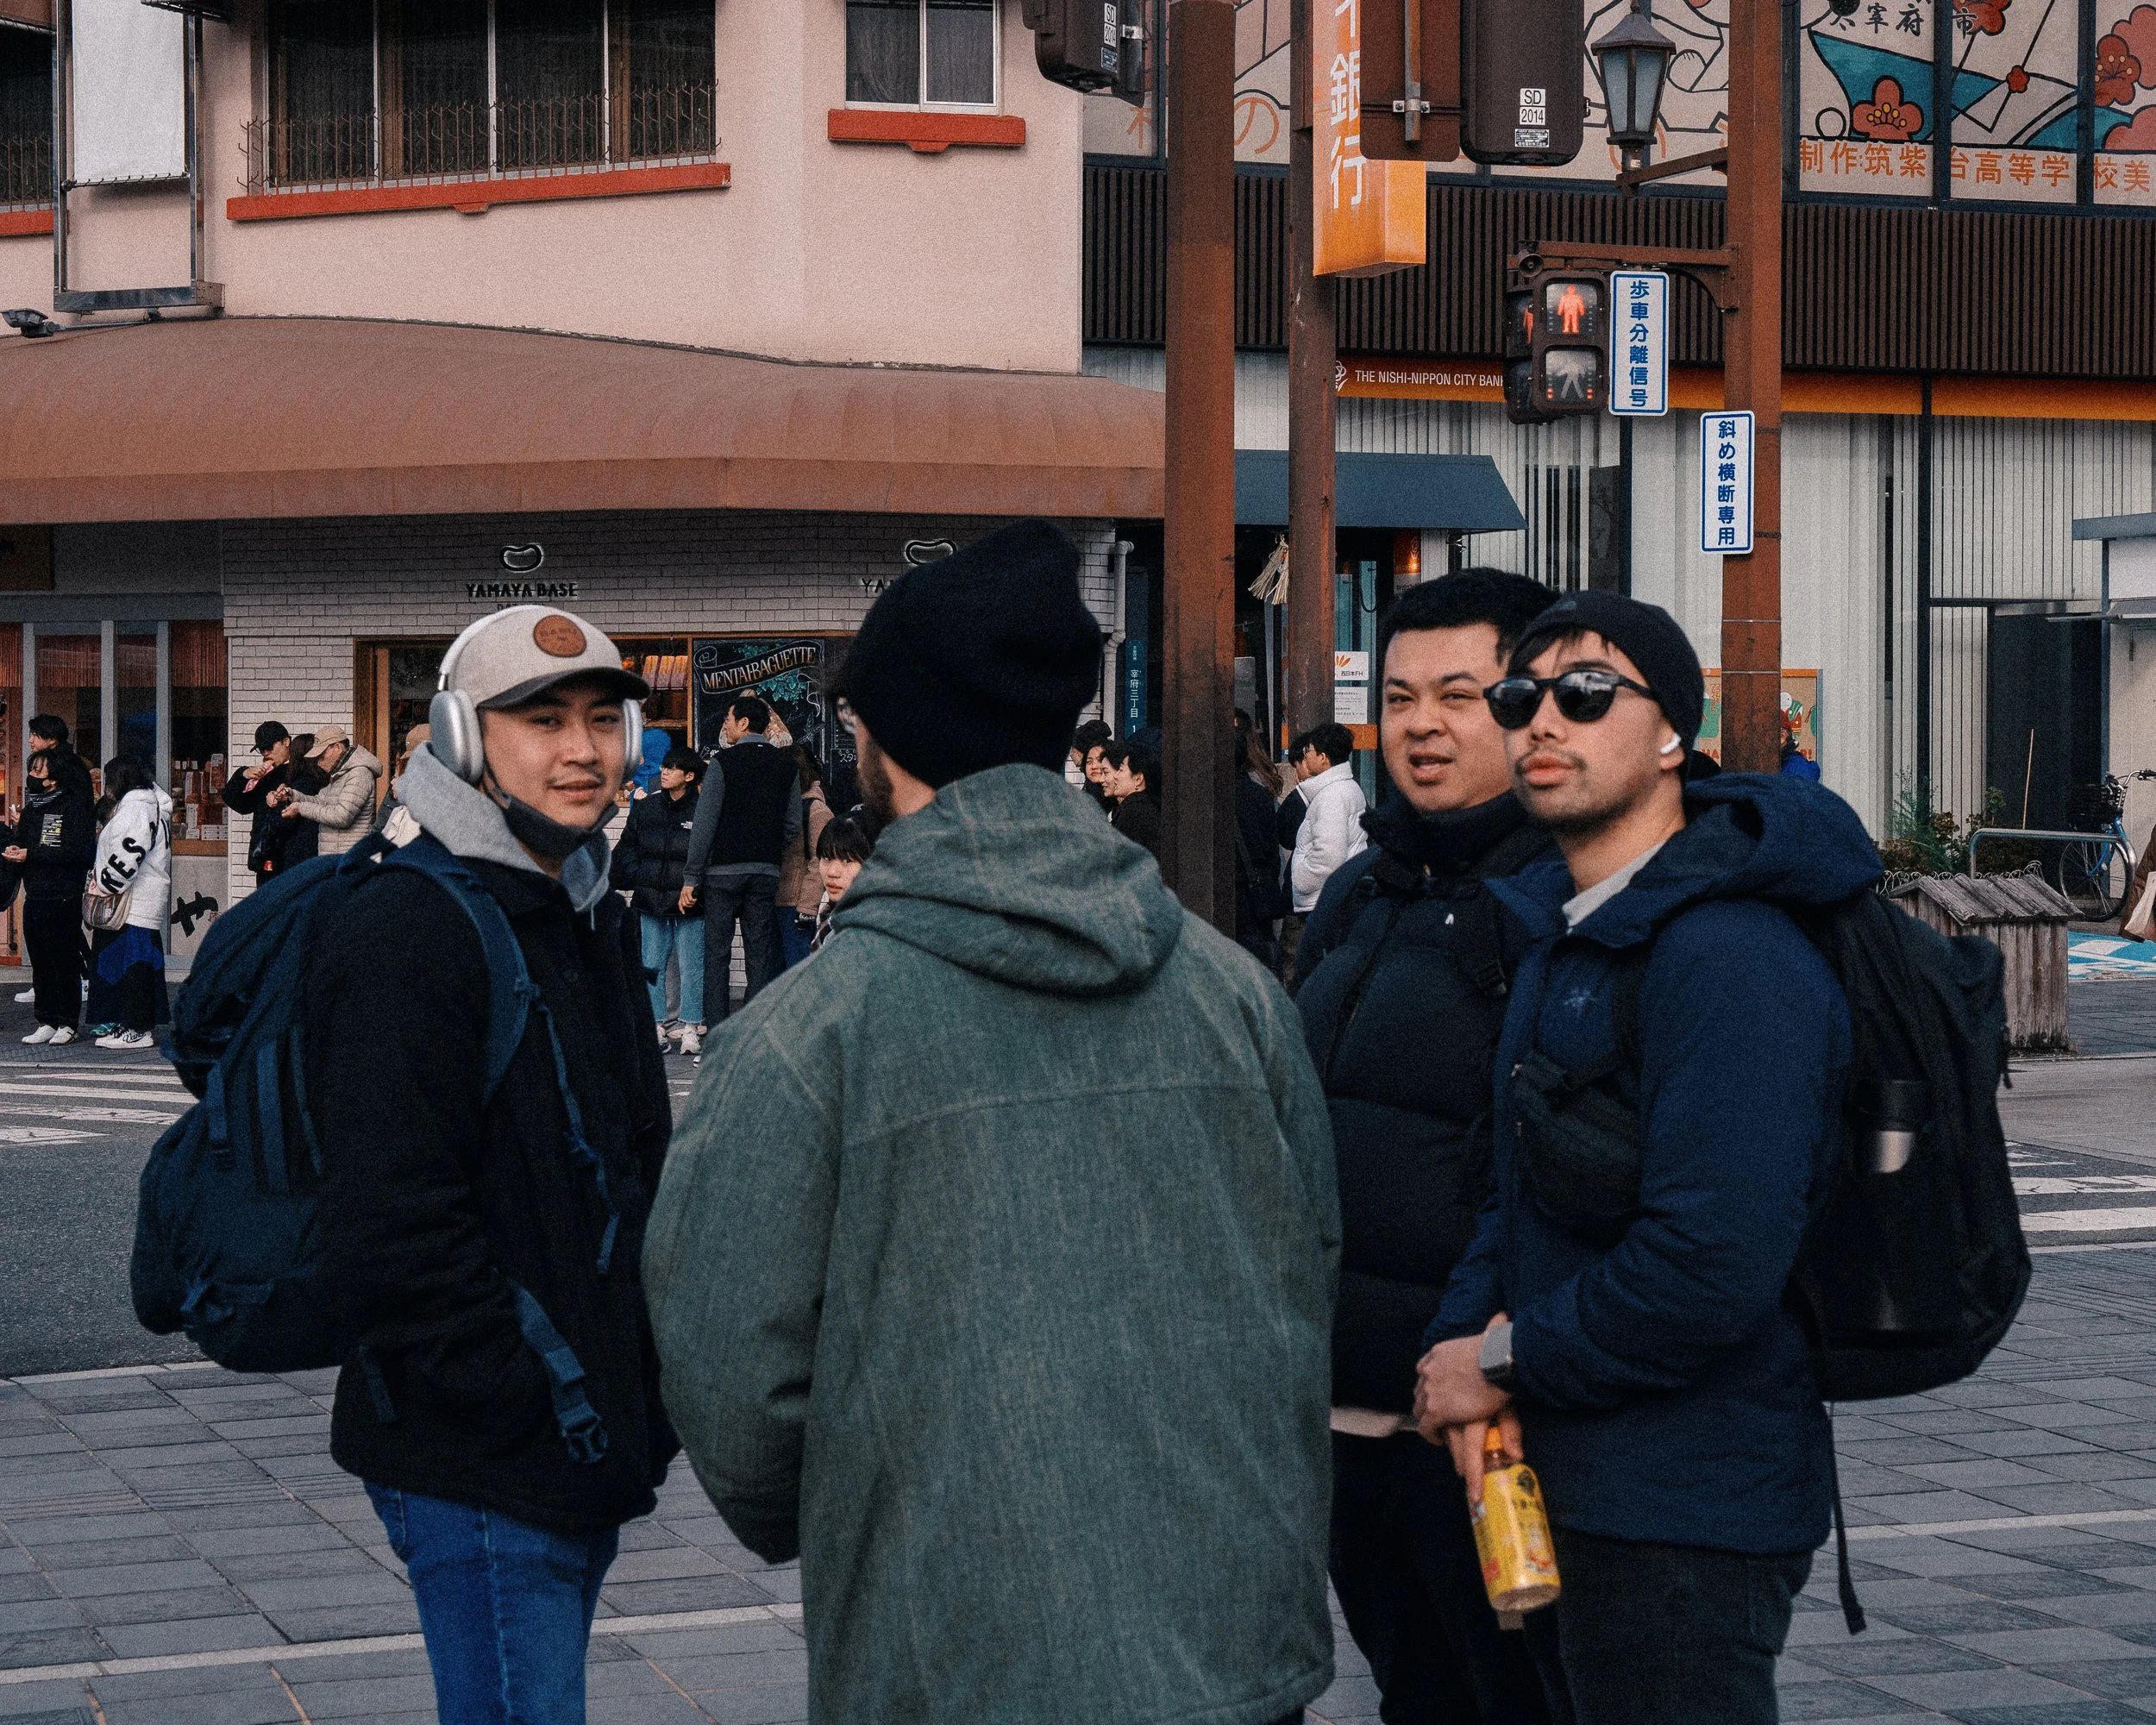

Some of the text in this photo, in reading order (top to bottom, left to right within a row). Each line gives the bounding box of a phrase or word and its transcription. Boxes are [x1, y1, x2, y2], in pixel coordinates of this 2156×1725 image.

[1106, 5, 1114, 22] SD
[1524, 90, 1542, 104] SD
[1521, 109, 1544, 123] 2014
[1629, 279, 1649, 407] 歩車分離信号
[1355, 370, 1376, 383] THE
[1378, 371, 1451, 386] NISHI-NIPPON
[1453, 373, 1476, 386] CITY
[1718, 420, 1736, 545] 斜め横断専用
[466, 582, 578, 598] YAMAYA BASE
[1130, 668, 1139, 718] 宰府三丁目
